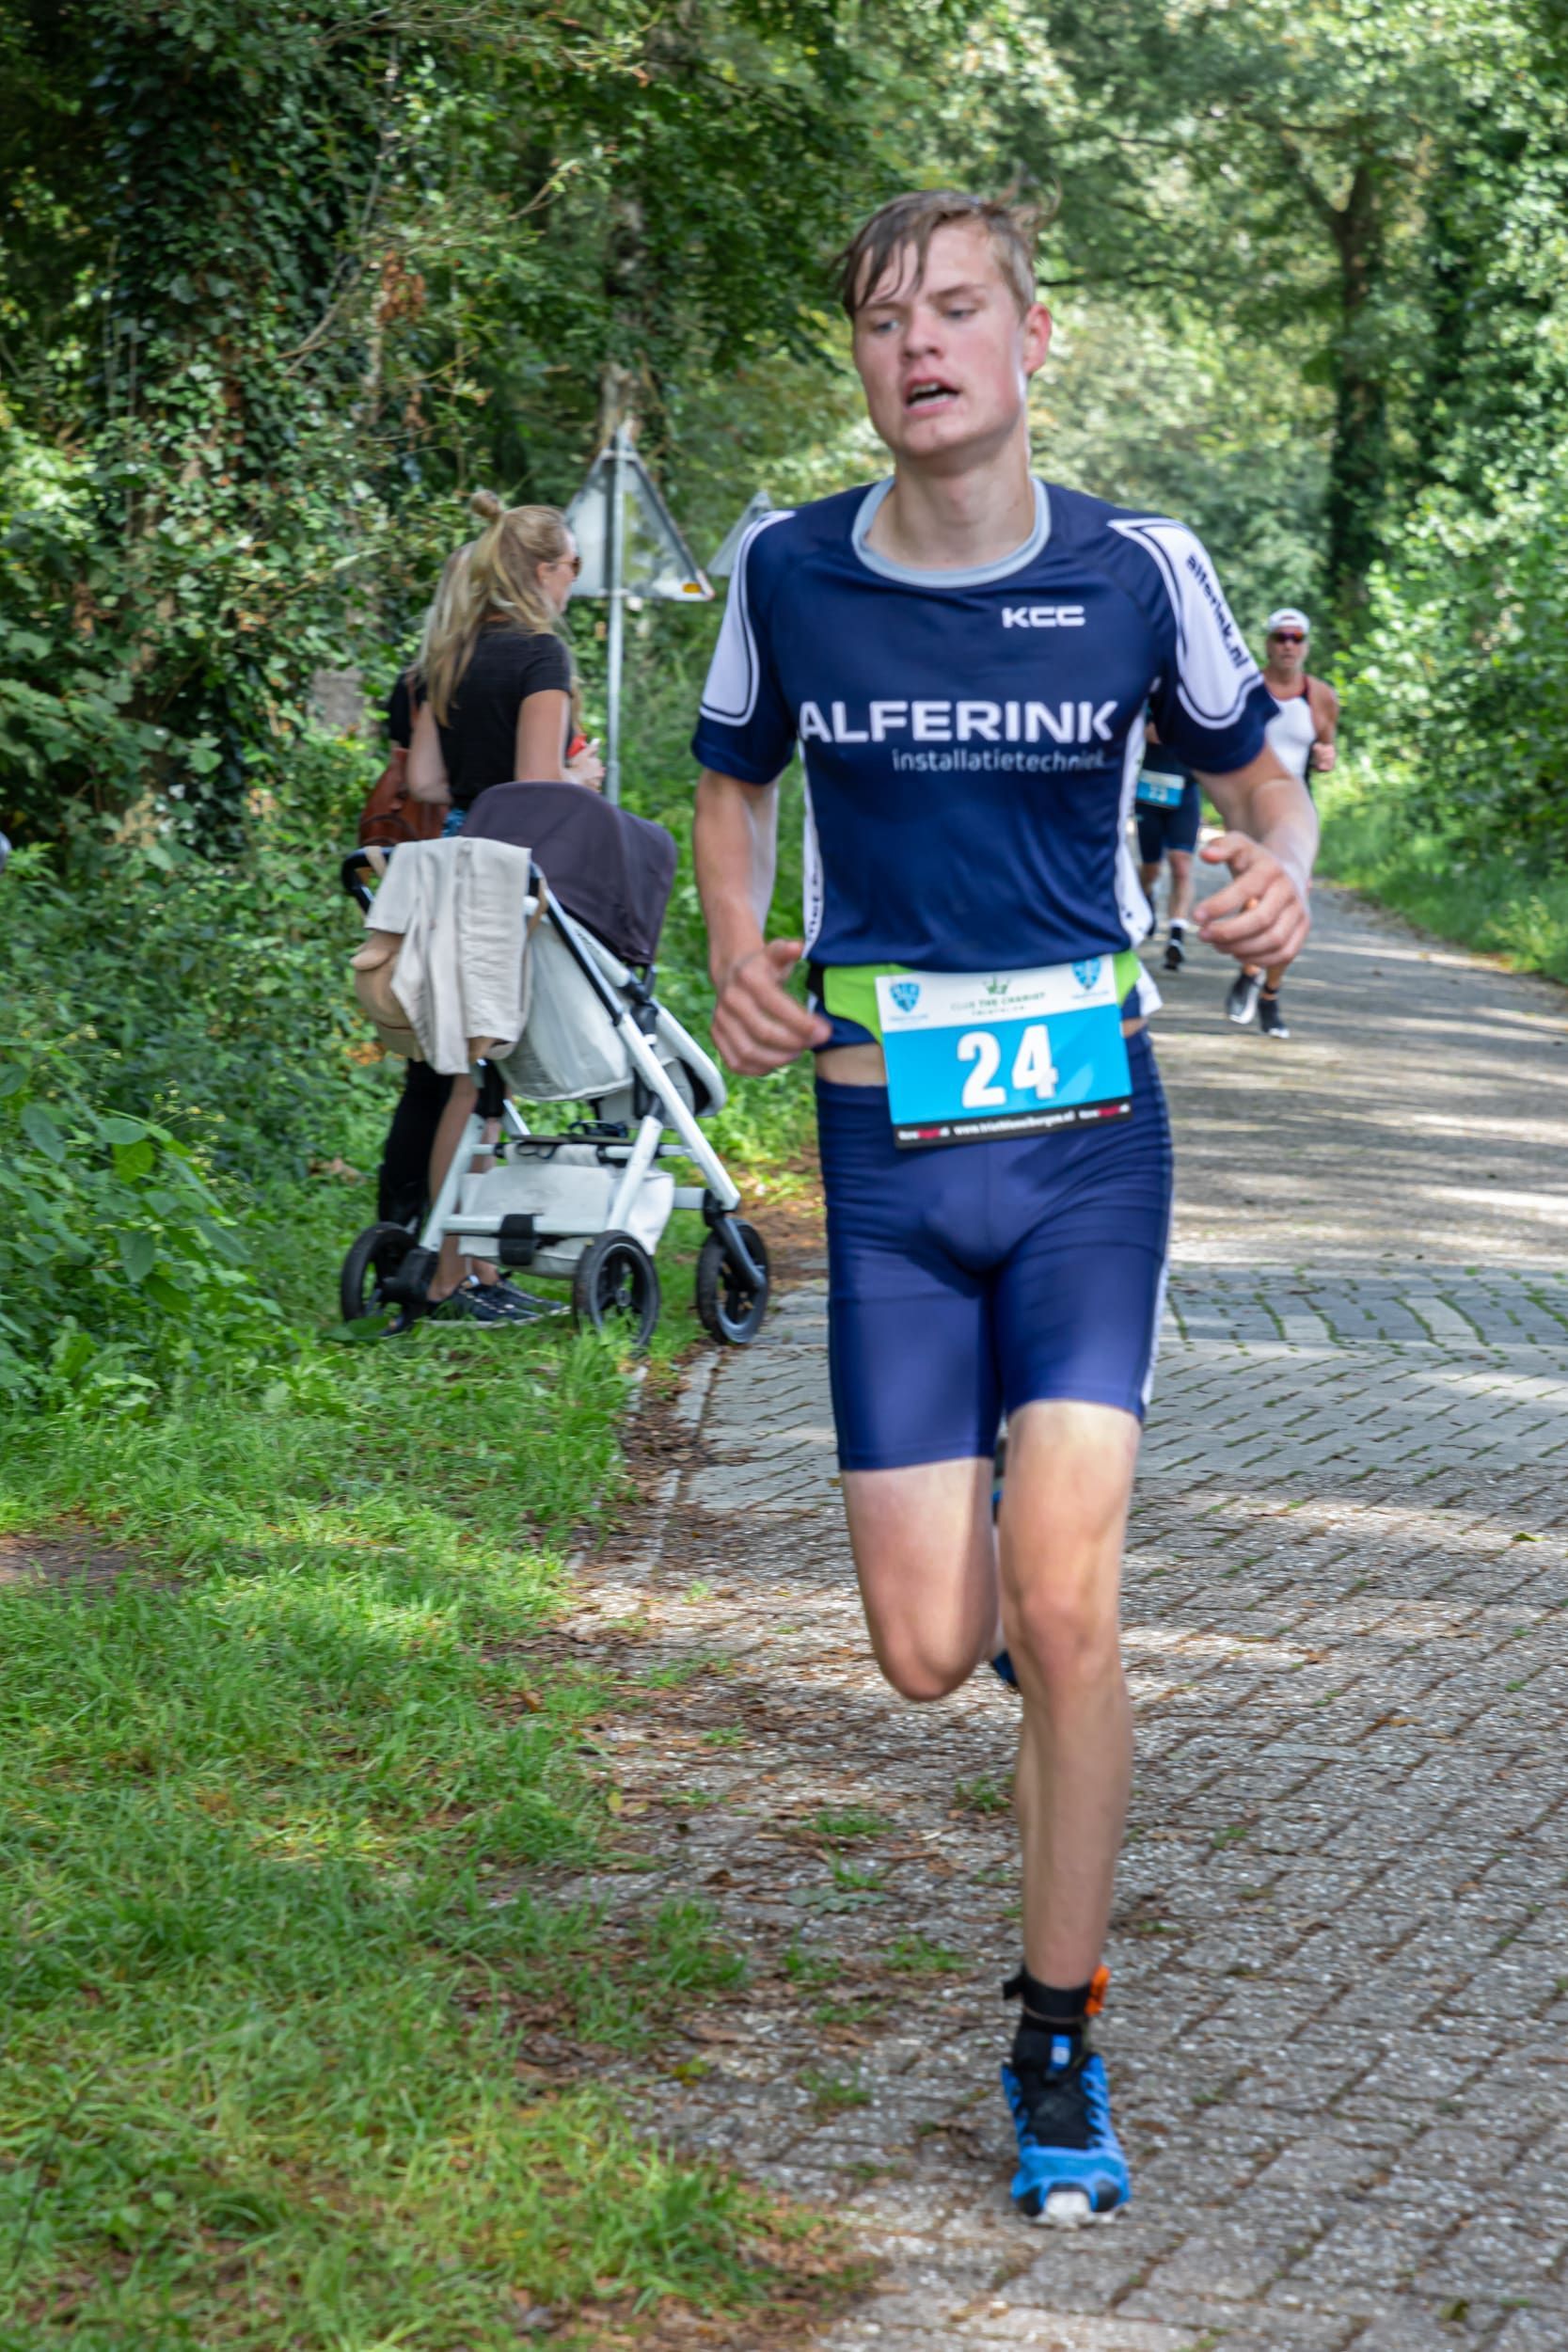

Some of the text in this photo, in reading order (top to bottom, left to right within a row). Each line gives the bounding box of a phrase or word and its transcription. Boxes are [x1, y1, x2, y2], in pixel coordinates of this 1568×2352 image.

[1002, 605, 1085, 628] KCC
[1186, 553, 1249, 669] alferink.nl
[799, 700, 1118, 744] ALFERINK
[957, 1025, 1059, 1108] 24
